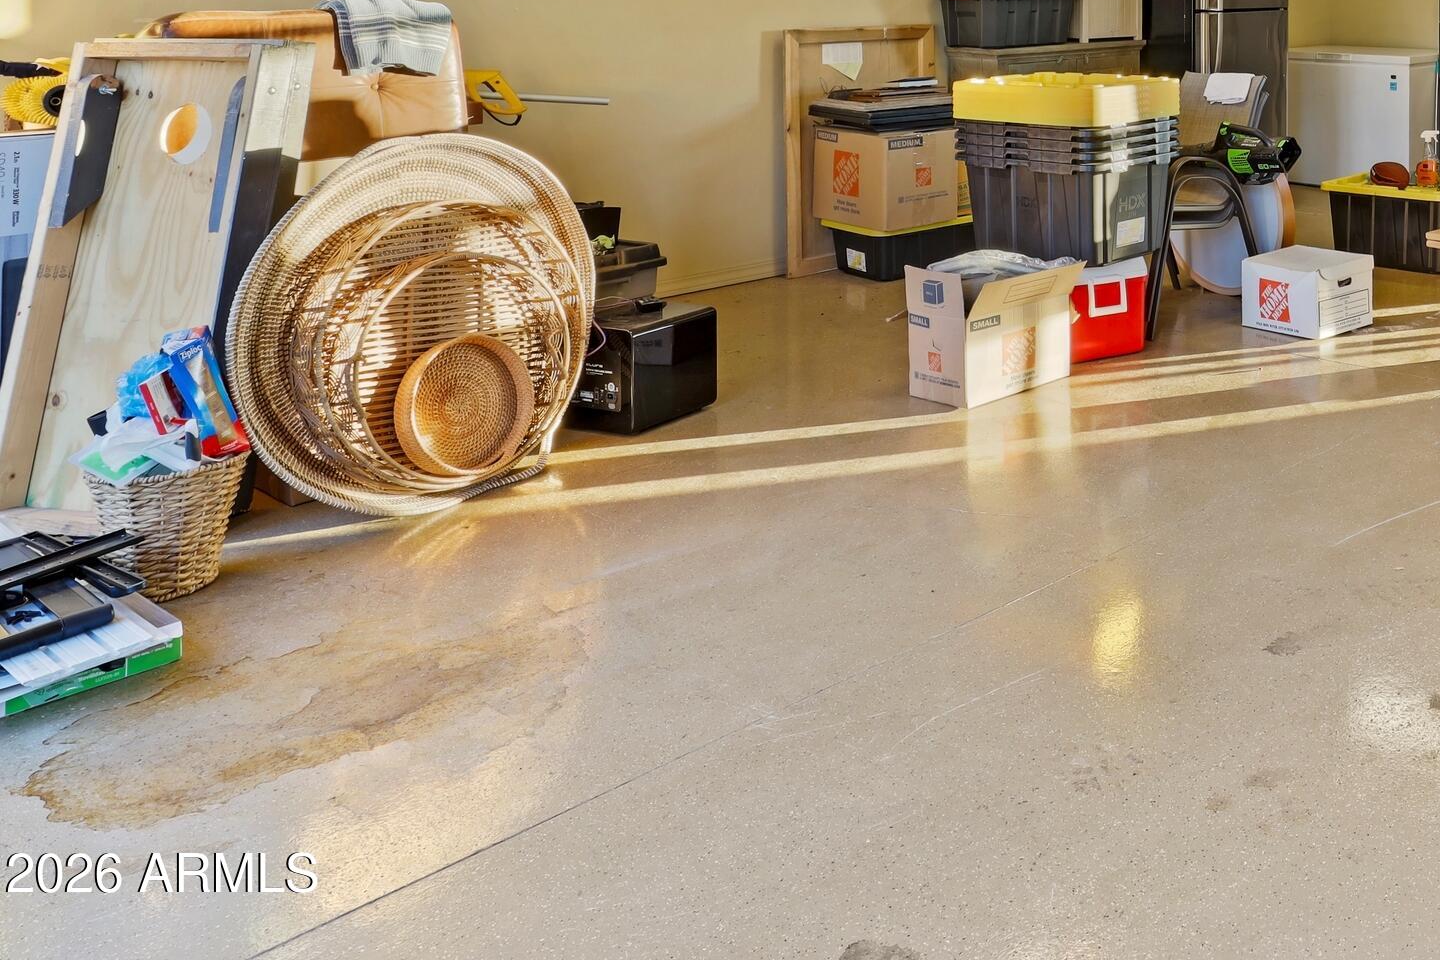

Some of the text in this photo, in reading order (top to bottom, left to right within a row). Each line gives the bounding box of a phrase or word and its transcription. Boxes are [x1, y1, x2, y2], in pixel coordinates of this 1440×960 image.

[818, 132, 838, 141] MEDIUM
[890, 138, 922, 149] MEDIUM
[833, 152, 859, 193] HOME
[1119, 193, 1146, 213] HDX
[1260, 281, 1290, 319] HOME
[1272, 298, 1290, 320] DEPOT
[910, 315, 928, 327] SMALL
[973, 317, 998, 330] SMALL
[180, 345, 203, 360] Ziploc
